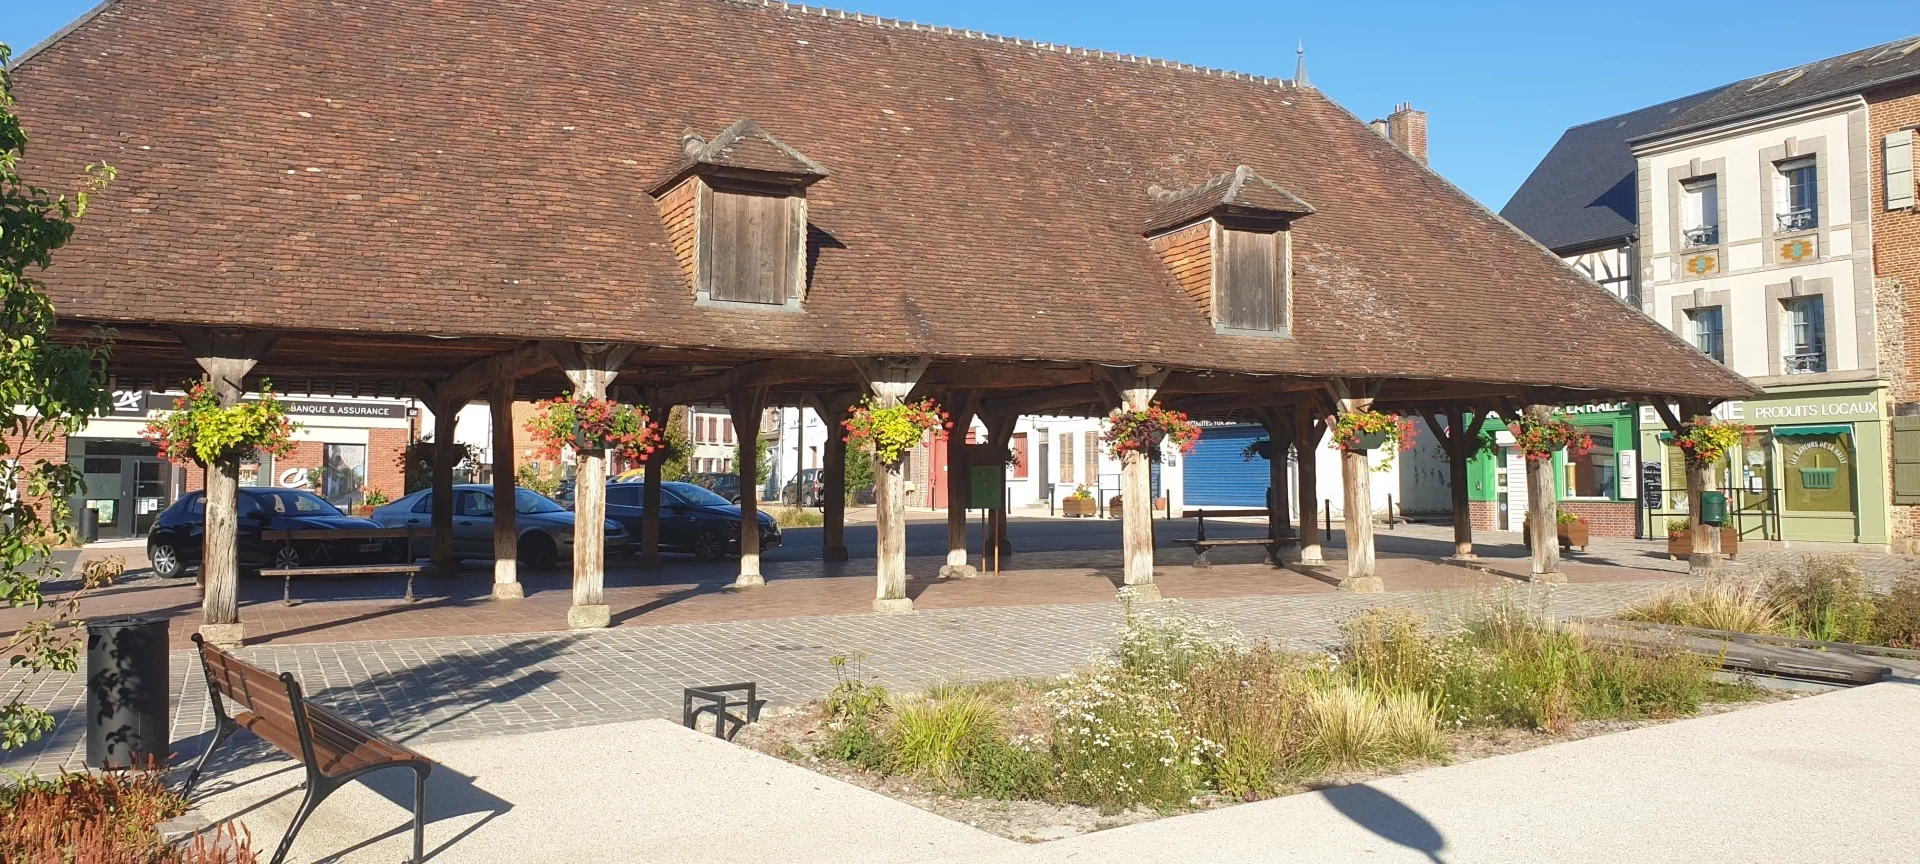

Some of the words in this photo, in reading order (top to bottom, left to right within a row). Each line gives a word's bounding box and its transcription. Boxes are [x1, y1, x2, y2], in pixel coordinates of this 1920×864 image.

[290, 405, 327, 413] BANQUE
[337, 406, 389, 416] ASSURANCE
[1755, 404, 1818, 419] PRODUITS
[1821, 401, 1878, 416] LOCAUX
[1795, 441, 1819, 457] SAVEURS
